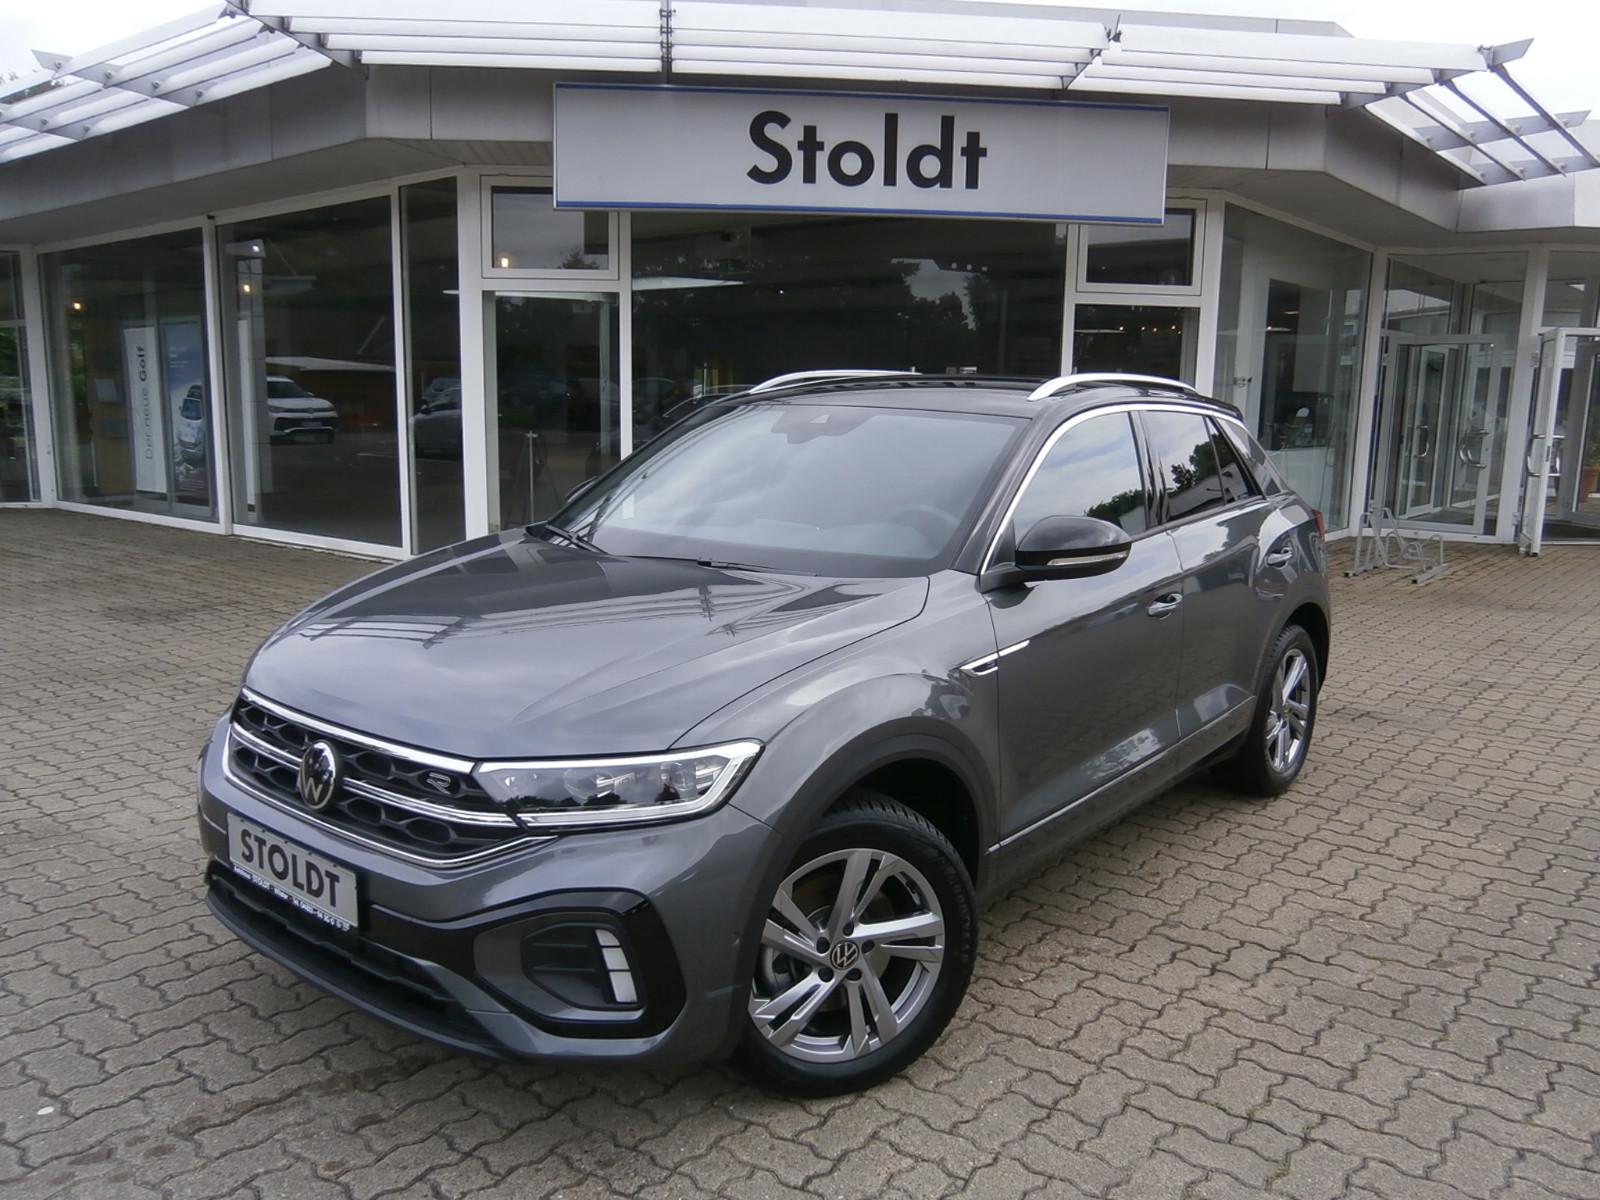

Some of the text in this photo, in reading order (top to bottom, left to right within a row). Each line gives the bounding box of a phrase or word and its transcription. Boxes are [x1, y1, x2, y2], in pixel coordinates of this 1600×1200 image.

[746, 110, 988, 190] Stoldt
[136, 345, 147, 382] Golf
[142, 387, 152, 429] neue
[240, 828, 340, 908] STOLDT
